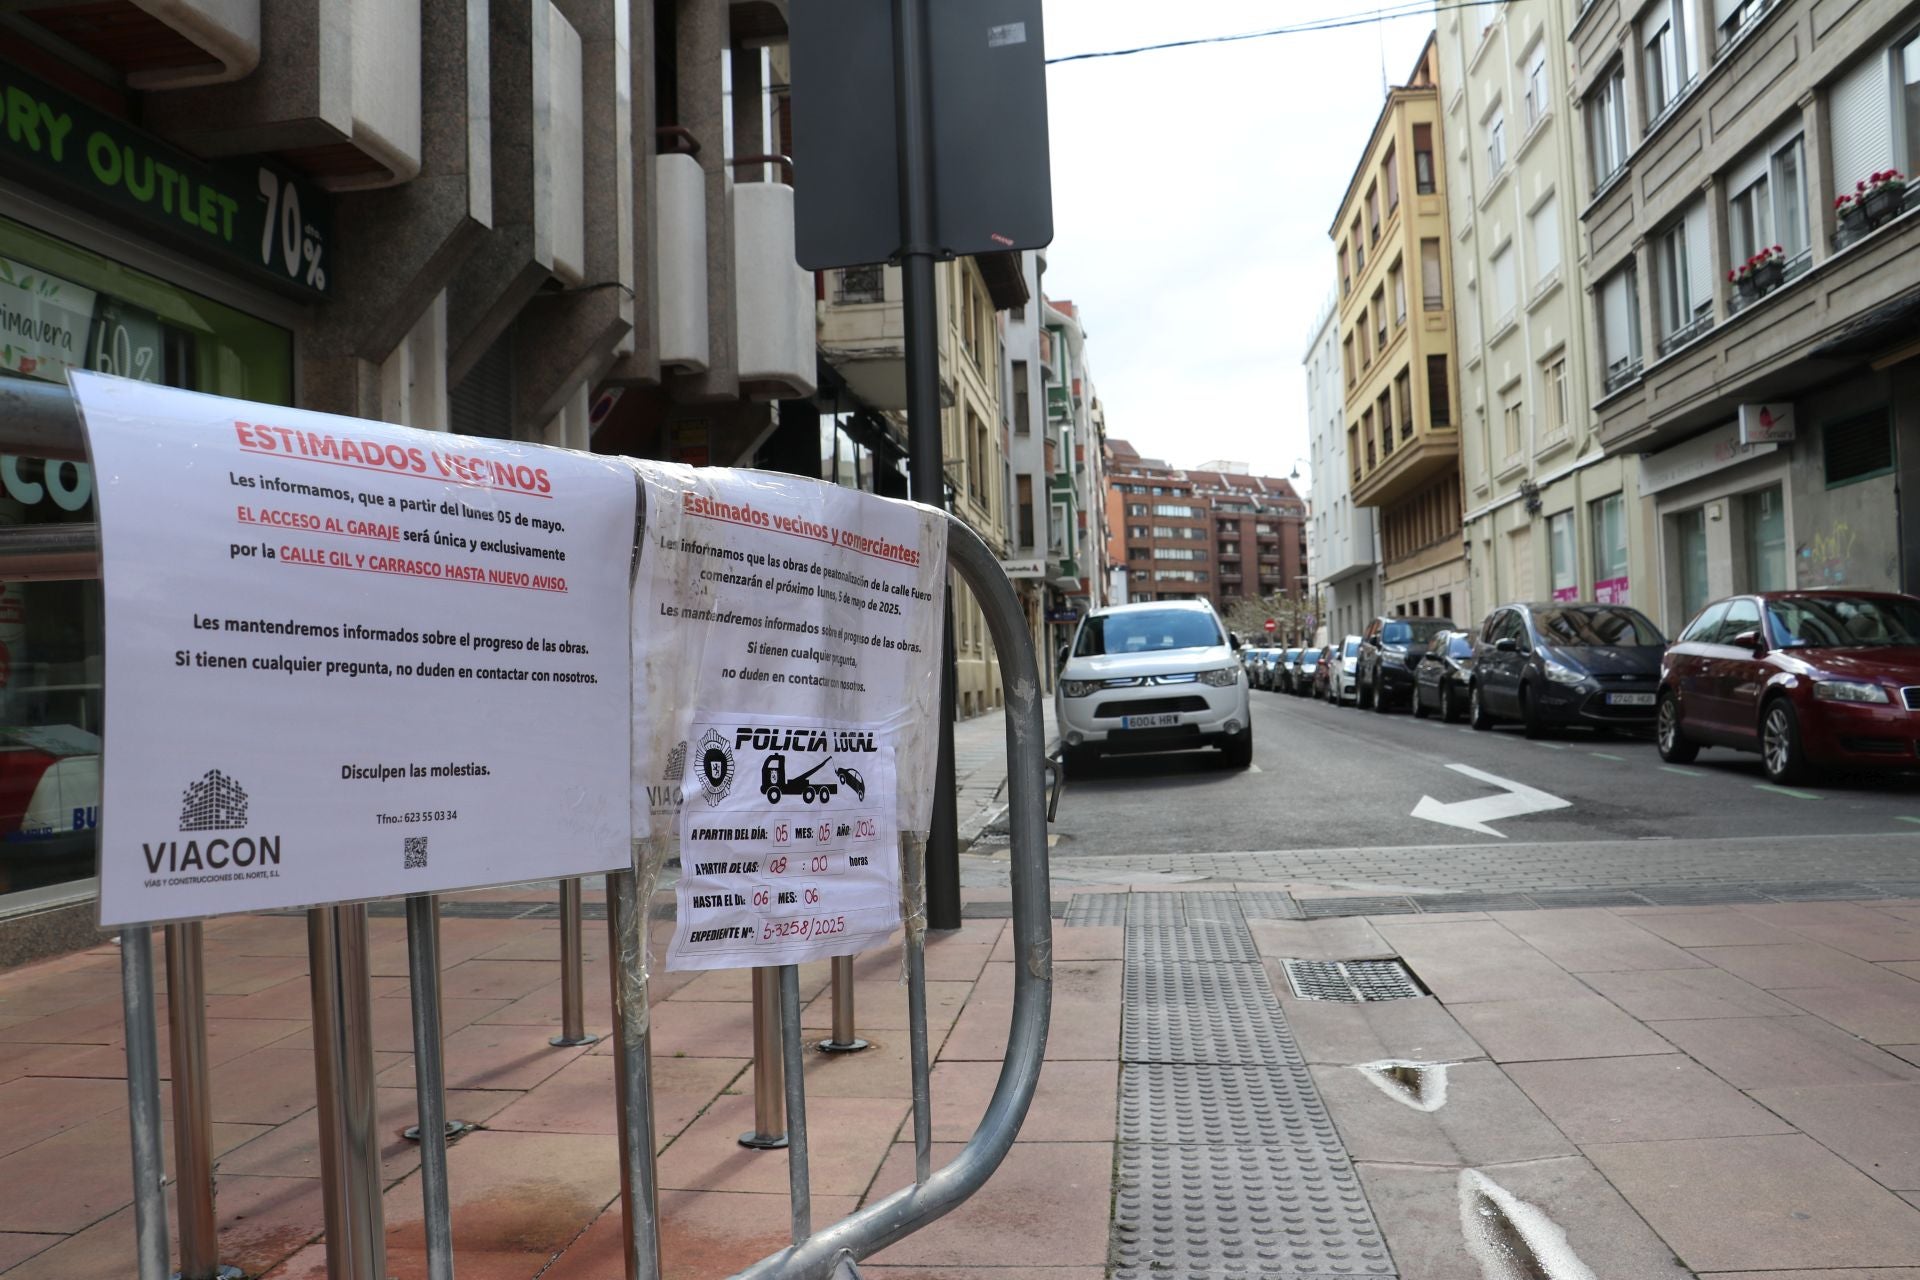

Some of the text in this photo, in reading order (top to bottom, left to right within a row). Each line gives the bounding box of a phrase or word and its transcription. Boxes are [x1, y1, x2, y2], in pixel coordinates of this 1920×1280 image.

[87, 131, 239, 243] OUTLET
[235, 421, 551, 493] ESTIMADOS VECINOS
[229, 471, 565, 533] Les informamos, que a partir del lunes 05 de mayo.
[237, 506, 566, 561] EL ACCESO AL GARAJE será única y exclusivamente
[683, 492, 921, 565] Estimados vecinos y comerciantes:
[230, 542, 568, 592] por la CALLE GIL Y CARRASCO HASTA NUEVO AVISO.
[660, 535, 677, 550] Les
[681, 538, 744, 561] informamos
[747, 553, 765, 567] que
[767, 553, 780, 568] las
[783, 558, 808, 573] obras
[810, 562, 821, 575] de
[870, 578, 880, 591] de
[882, 580, 889, 593] la
[891, 584, 909, 597] calle
[911, 588, 932, 601] Fuero
[700, 569, 902, 615] comenzarán el próximo lunes, 5 de mayo de 2025.
[193, 613, 589, 654] Les mantendremos informados sobre el progreso de las obras.
[660, 603, 679, 617] Les
[681, 608, 763, 628] mantendremos
[765, 616, 819, 635] informados
[821, 624, 838, 638] sobre
[838, 628, 843, 639] el
[871, 634, 881, 646] de
[883, 636, 895, 649] las
[897, 640, 922, 653] obras.
[175, 650, 598, 684] Si tienen cualquier pregunta, no duden en contactar con nosotros.
[747, 641, 757, 654] Si
[759, 642, 788, 657] tienen
[791, 648, 832, 663] cualquier
[722, 668, 736, 679] no
[739, 667, 770, 681] duden
[772, 672, 785, 683] en
[1130, 716, 1156, 728] 6004
[735, 728, 878, 753] POLICIA LOCAL
[341, 762, 490, 782] Disculpen las molestias.
[376, 810, 457, 824] Tfno.: 623 55 03 34
[691, 829, 698, 840] A
[699, 829, 733, 840] PARTIR
[734, 829, 749, 840] DEL
[751, 826, 768, 840] DÍA:
[776, 825, 788, 842] 05
[795, 827, 814, 839] MES:
[819, 824, 830, 841] 05
[836, 823, 851, 836] AÑO:
[142, 835, 280, 874] VIACON
[695, 864, 702, 876] A
[701, 862, 727, 875] PARTIR
[729, 862, 741, 873] DE
[742, 861, 759, 873] LAS:
[769, 857, 787, 873] 08
[811, 855, 828, 872] 00
[849, 856, 869, 867] horas
[162, 879, 167, 887] Y
[168, 873, 232, 886] CONSTRUCCIONES
[233, 872, 246, 880] DEL
[693, 895, 723, 908] HASTA
[724, 894, 733, 906] EL
[753, 891, 769, 905] 06
[778, 892, 797, 904] MES:
[804, 888, 818, 904] 06
[690, 927, 740, 943] EXPEDIENTE
